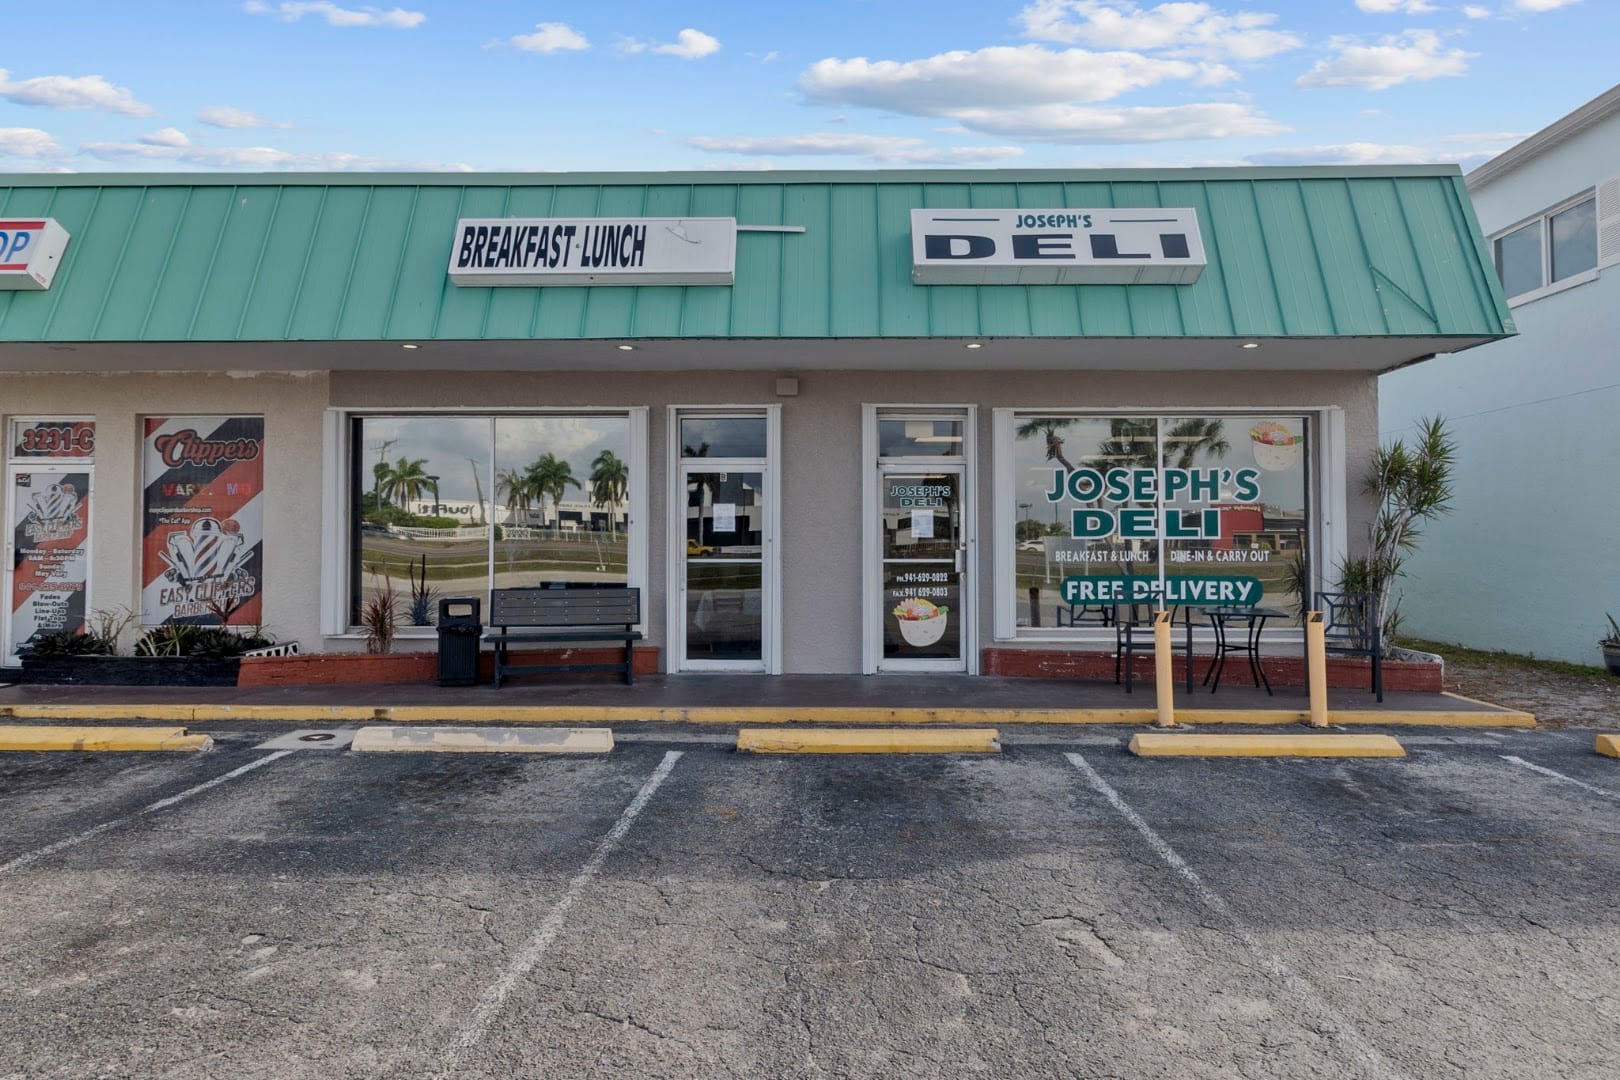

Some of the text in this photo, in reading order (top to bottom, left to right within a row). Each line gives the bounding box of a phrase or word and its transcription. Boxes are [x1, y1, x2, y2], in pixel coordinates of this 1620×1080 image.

[1015, 214, 1093, 229] JOSEPH'S
[457, 224, 647, 269] BREAKFAST LUNCH
[924, 233, 1191, 260] DELI
[23, 427, 94, 451] 3231-C
[155, 429, 258, 467] Clippers
[890, 485, 951, 497] JOSEPH'S
[1046, 467, 1260, 503] JOSEPH'S
[901, 497, 943, 507] DELI
[1070, 507, 1222, 540] DELI
[1055, 550, 1149, 563] BREAKFAST & LUNCH
[1170, 550, 1270, 563] DINE-IN & CARRY OUT
[160, 586, 193, 606] EASY
[1066, 580, 1253, 602] FREE DELIVERY
